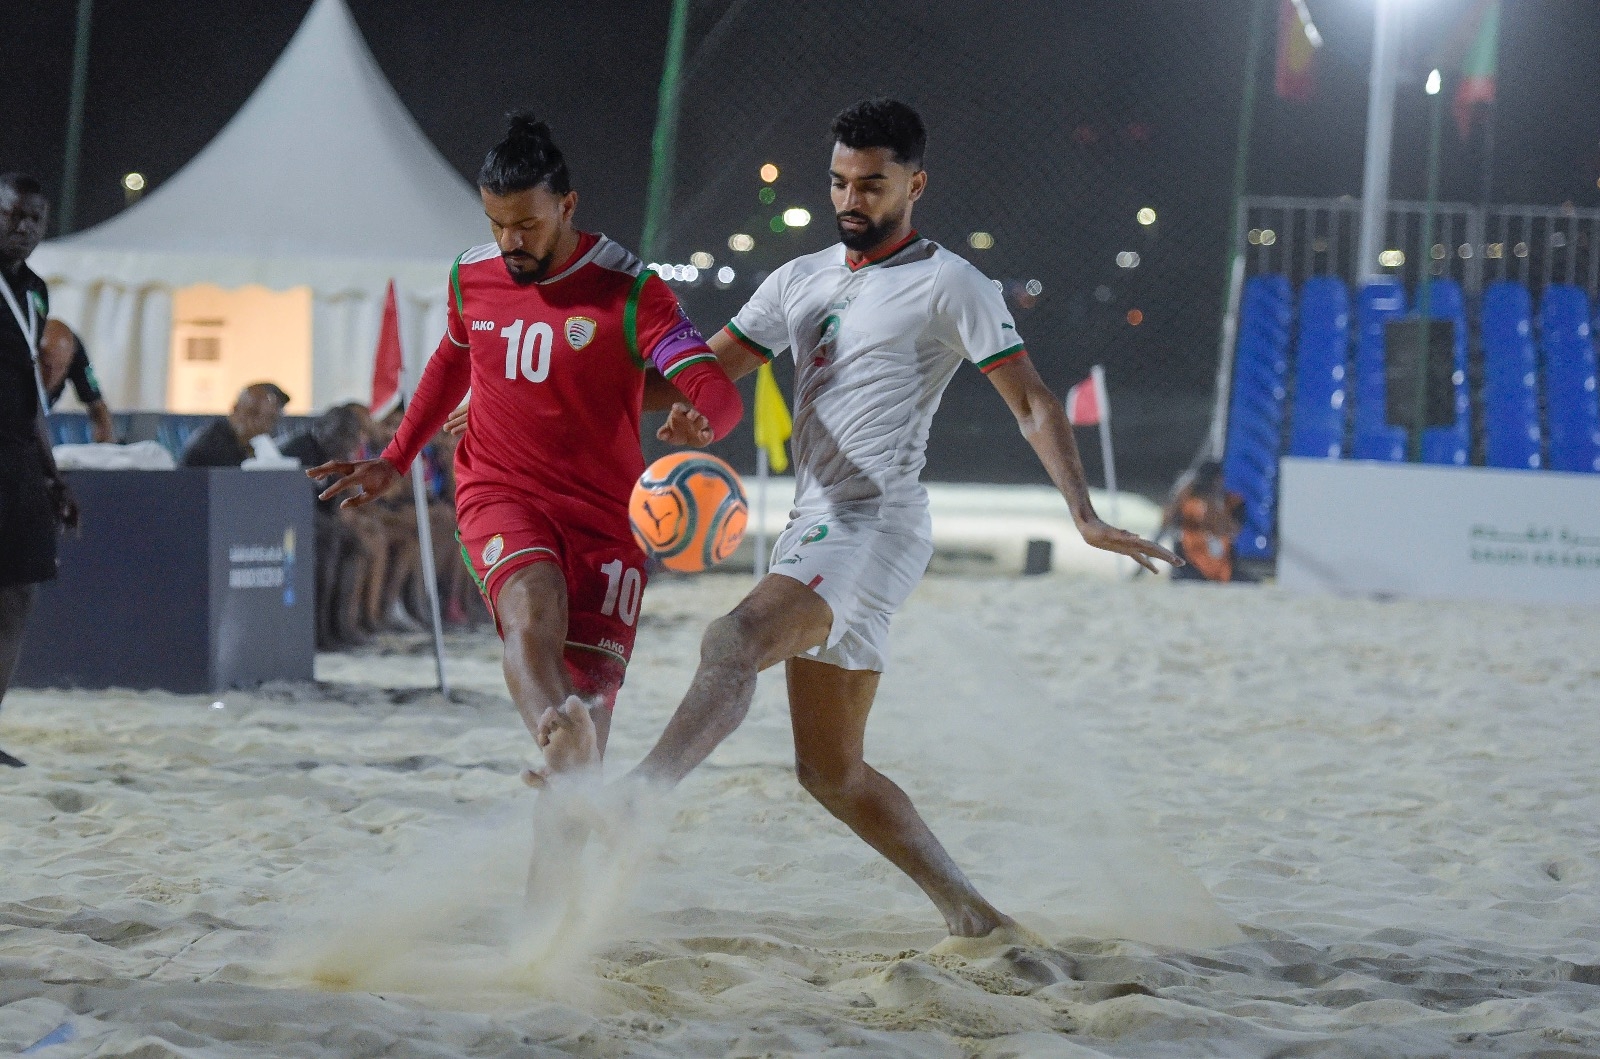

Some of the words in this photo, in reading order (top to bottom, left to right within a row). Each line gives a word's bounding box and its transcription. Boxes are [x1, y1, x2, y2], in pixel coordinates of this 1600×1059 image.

[471, 320, 495, 331] JAKO
[500, 318, 554, 383] 10
[600, 558, 641, 627] 10
[597, 637, 625, 653] JAKO
